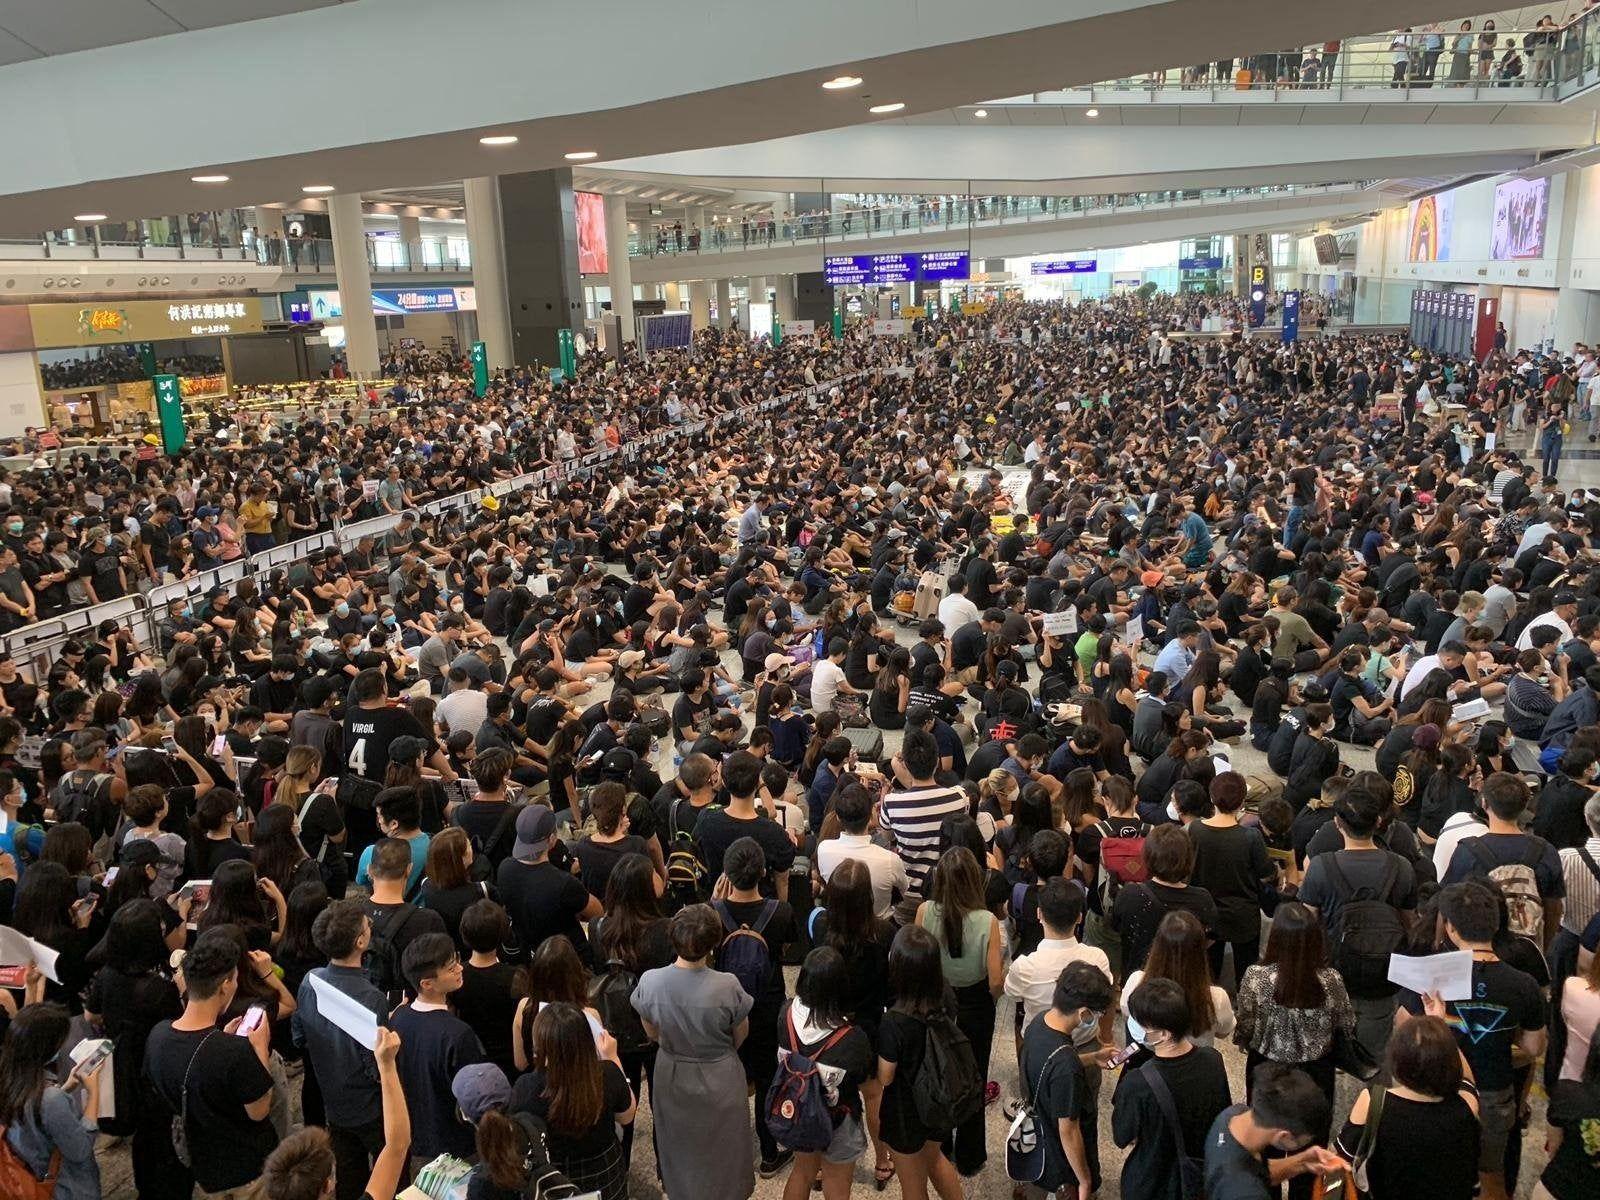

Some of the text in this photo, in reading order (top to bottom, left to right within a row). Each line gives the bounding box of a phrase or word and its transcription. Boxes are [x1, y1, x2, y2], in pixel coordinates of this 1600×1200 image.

[1253, 268, 1264, 281] B
[352, 722, 375, 734] VIRGIL
[348, 738, 367, 776] 4
